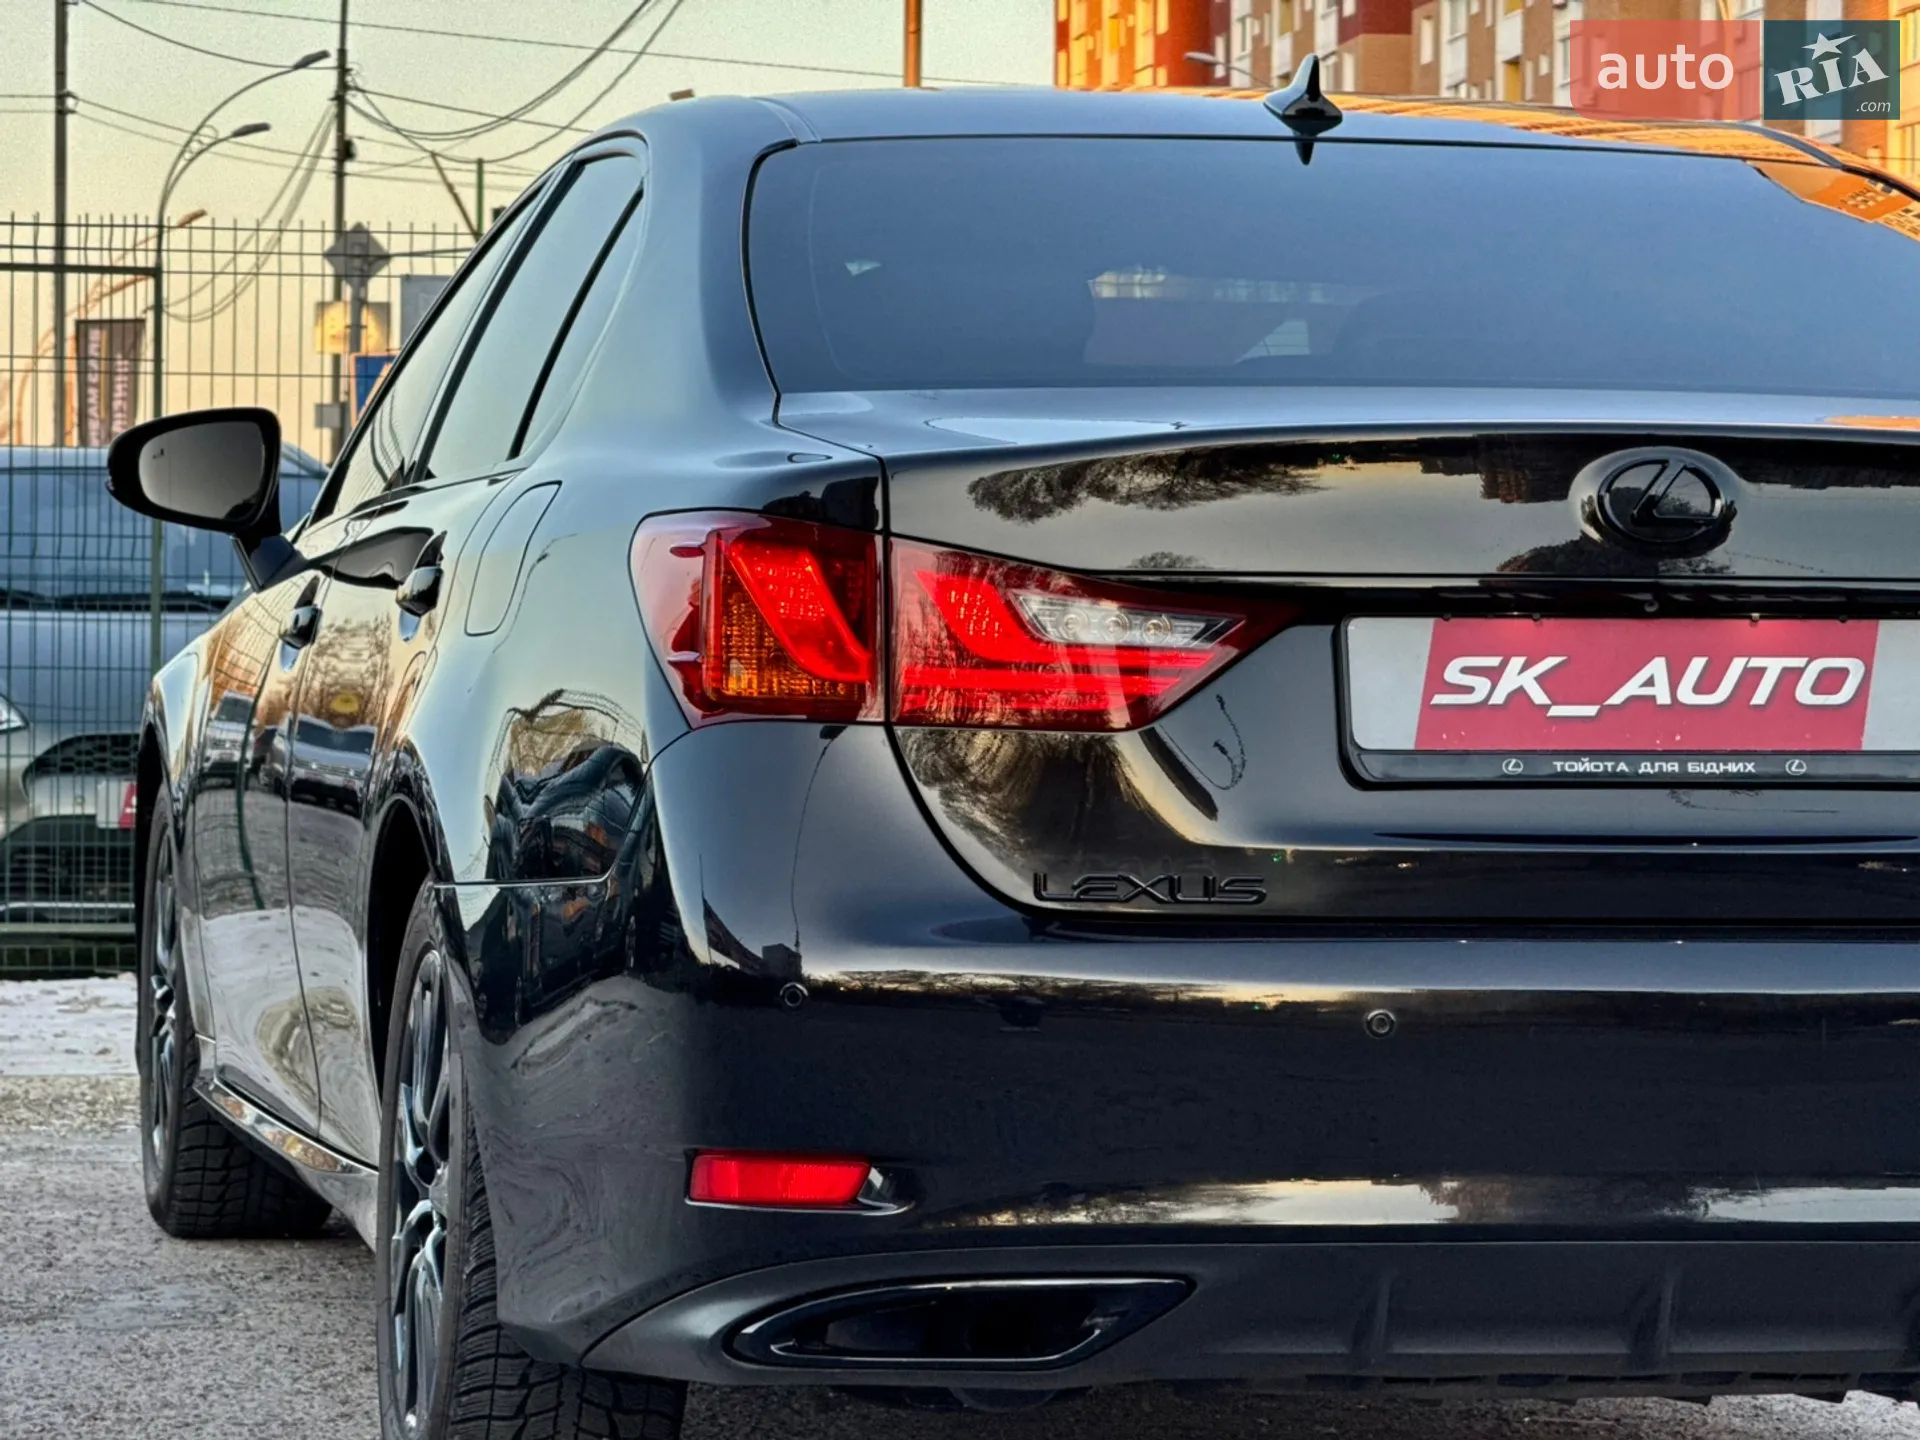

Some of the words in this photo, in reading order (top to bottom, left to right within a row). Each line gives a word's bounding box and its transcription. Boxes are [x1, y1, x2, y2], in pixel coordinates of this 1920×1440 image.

[1430, 656, 1866, 717] SK_AUTO
[1552, 757, 1629, 773] ТОЙОТА
[1638, 761, 1679, 774] ДЛЯ
[1687, 761, 1756, 774] БІДНИХ
[1033, 872, 1267, 905] LEXUS
